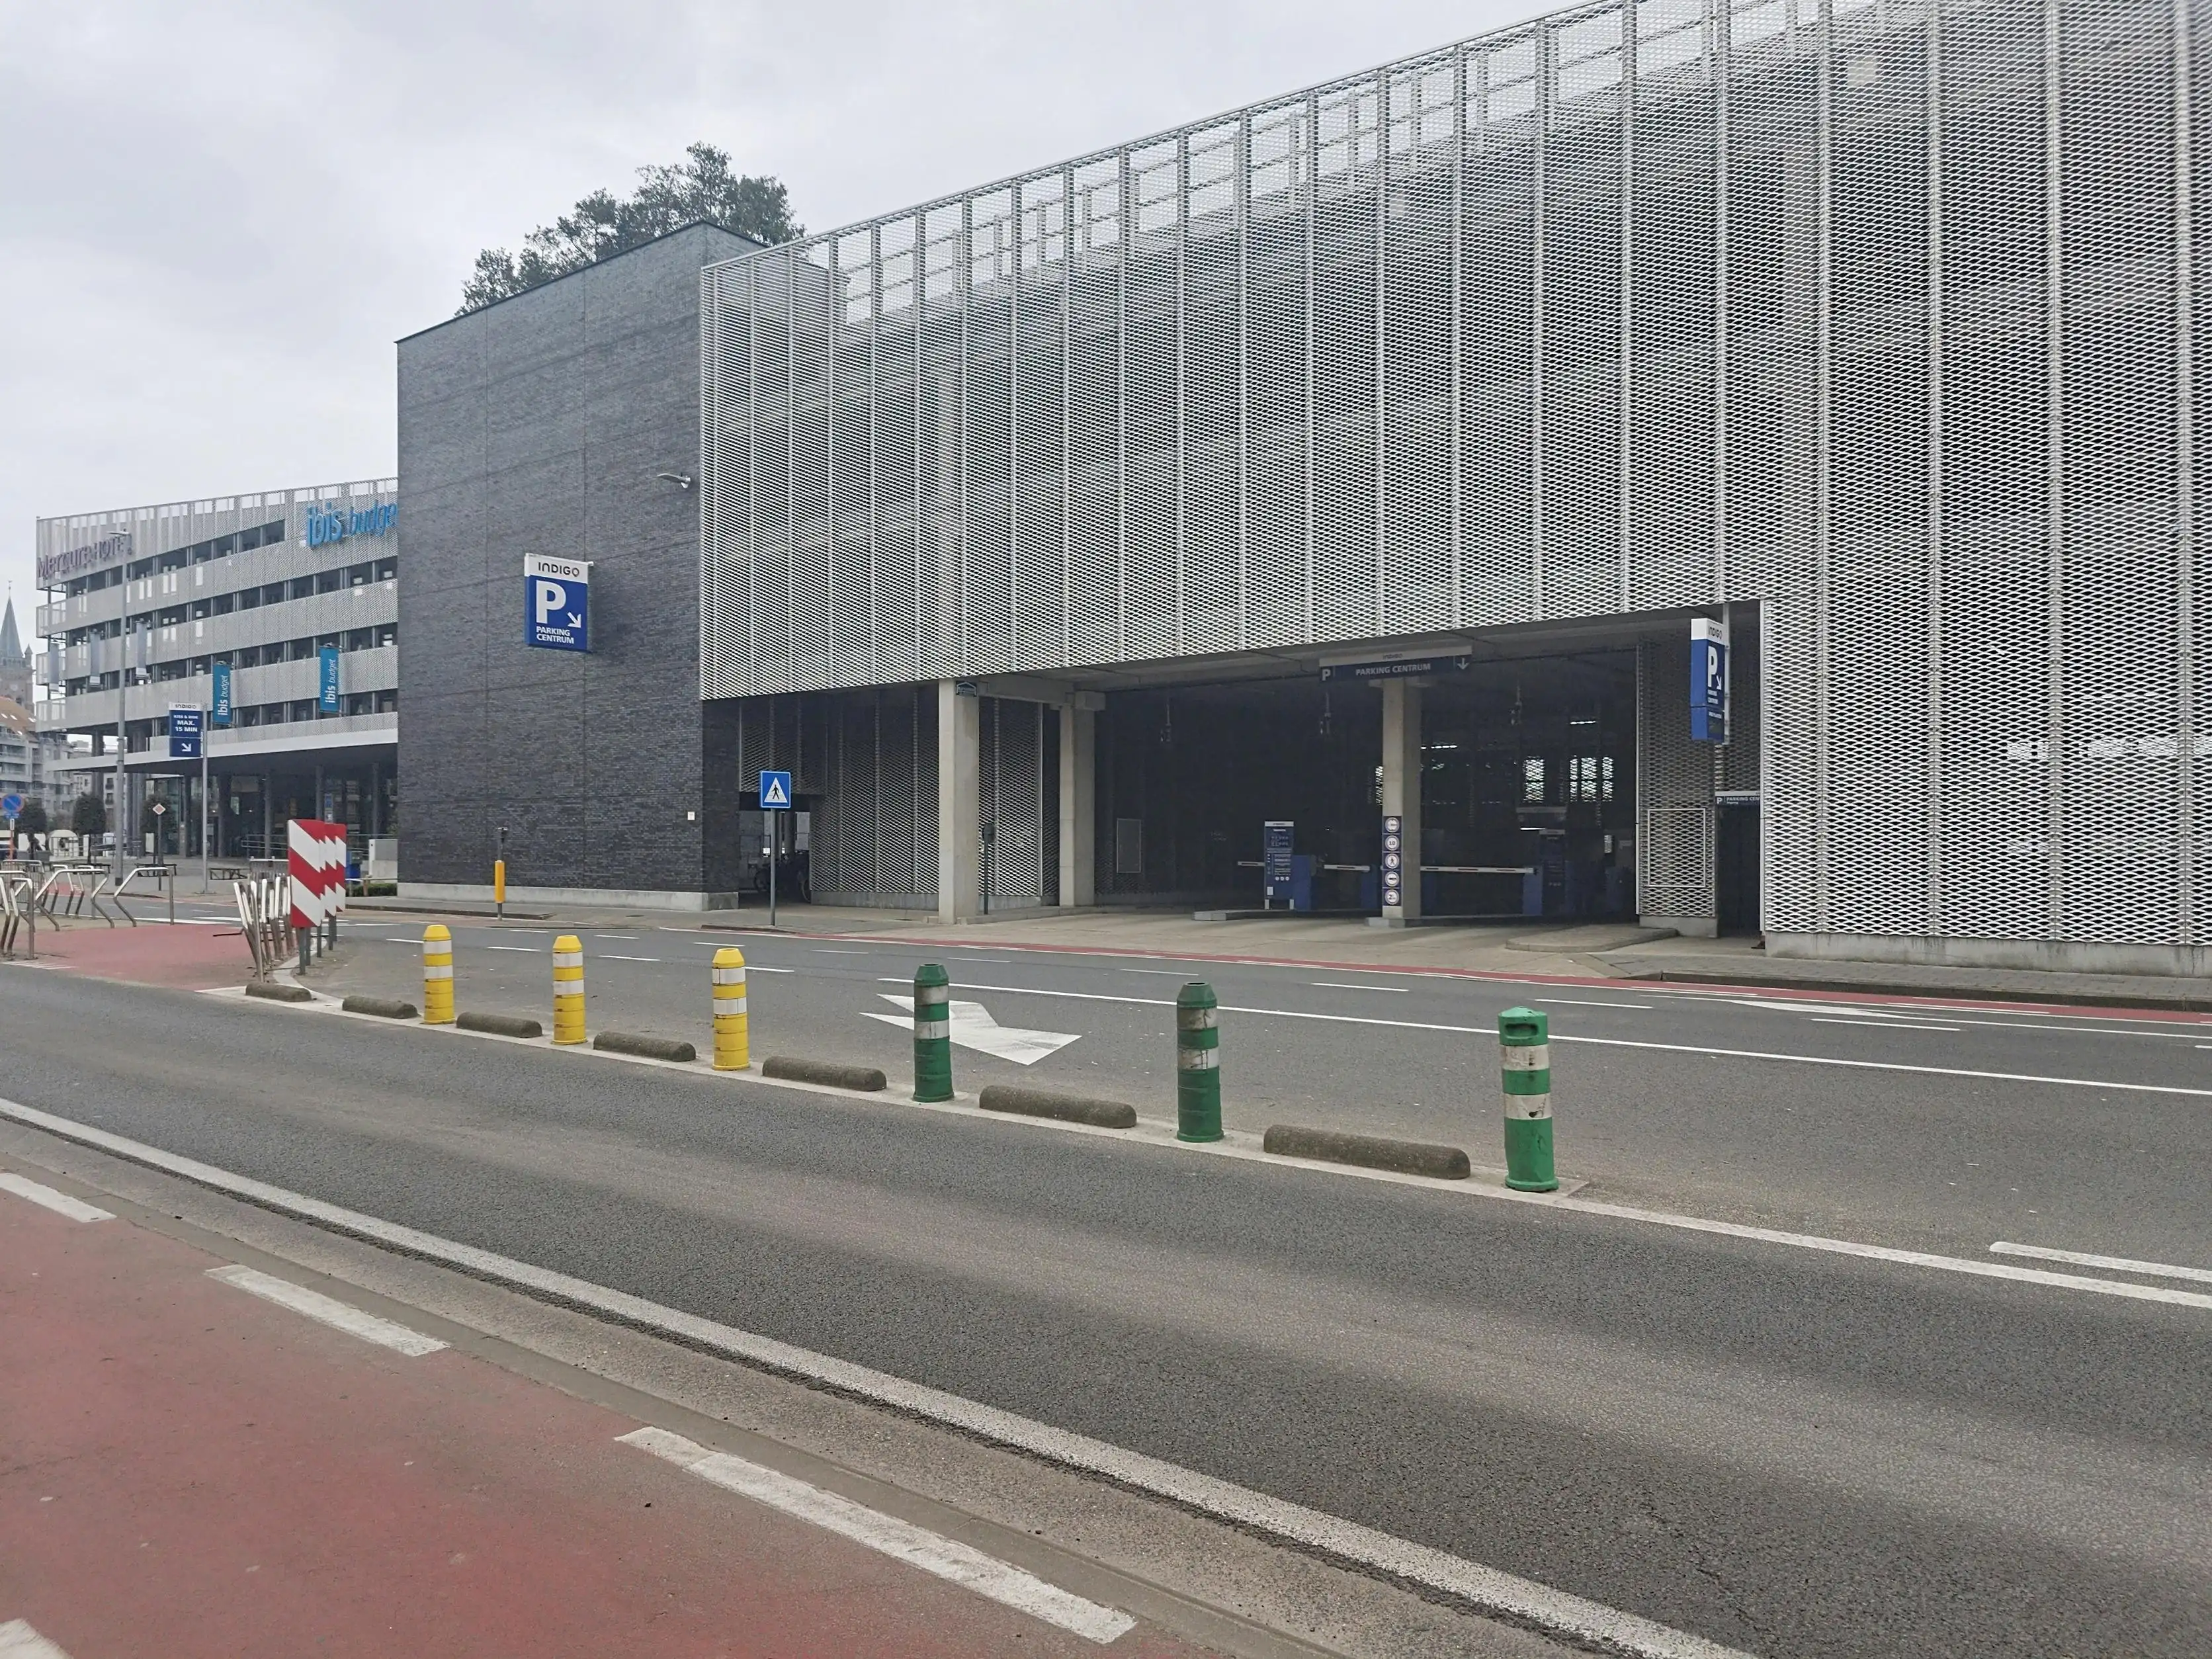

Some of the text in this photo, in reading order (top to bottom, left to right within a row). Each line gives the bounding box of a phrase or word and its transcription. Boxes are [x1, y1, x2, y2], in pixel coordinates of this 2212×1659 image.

[306, 499, 396, 548] ibis budge
[538, 562, 579, 577] INDIGO
[536, 579, 566, 624] P
[536, 626, 570, 636] PARKING
[536, 633, 574, 644] CENTRUM
[1322, 669, 1331, 681] P
[1356, 663, 1431, 676] PARKING CENTRUM
[1707, 645, 1718, 687] P
[218, 674, 230, 716] ibis budget
[325, 659, 337, 703] ibis budget
